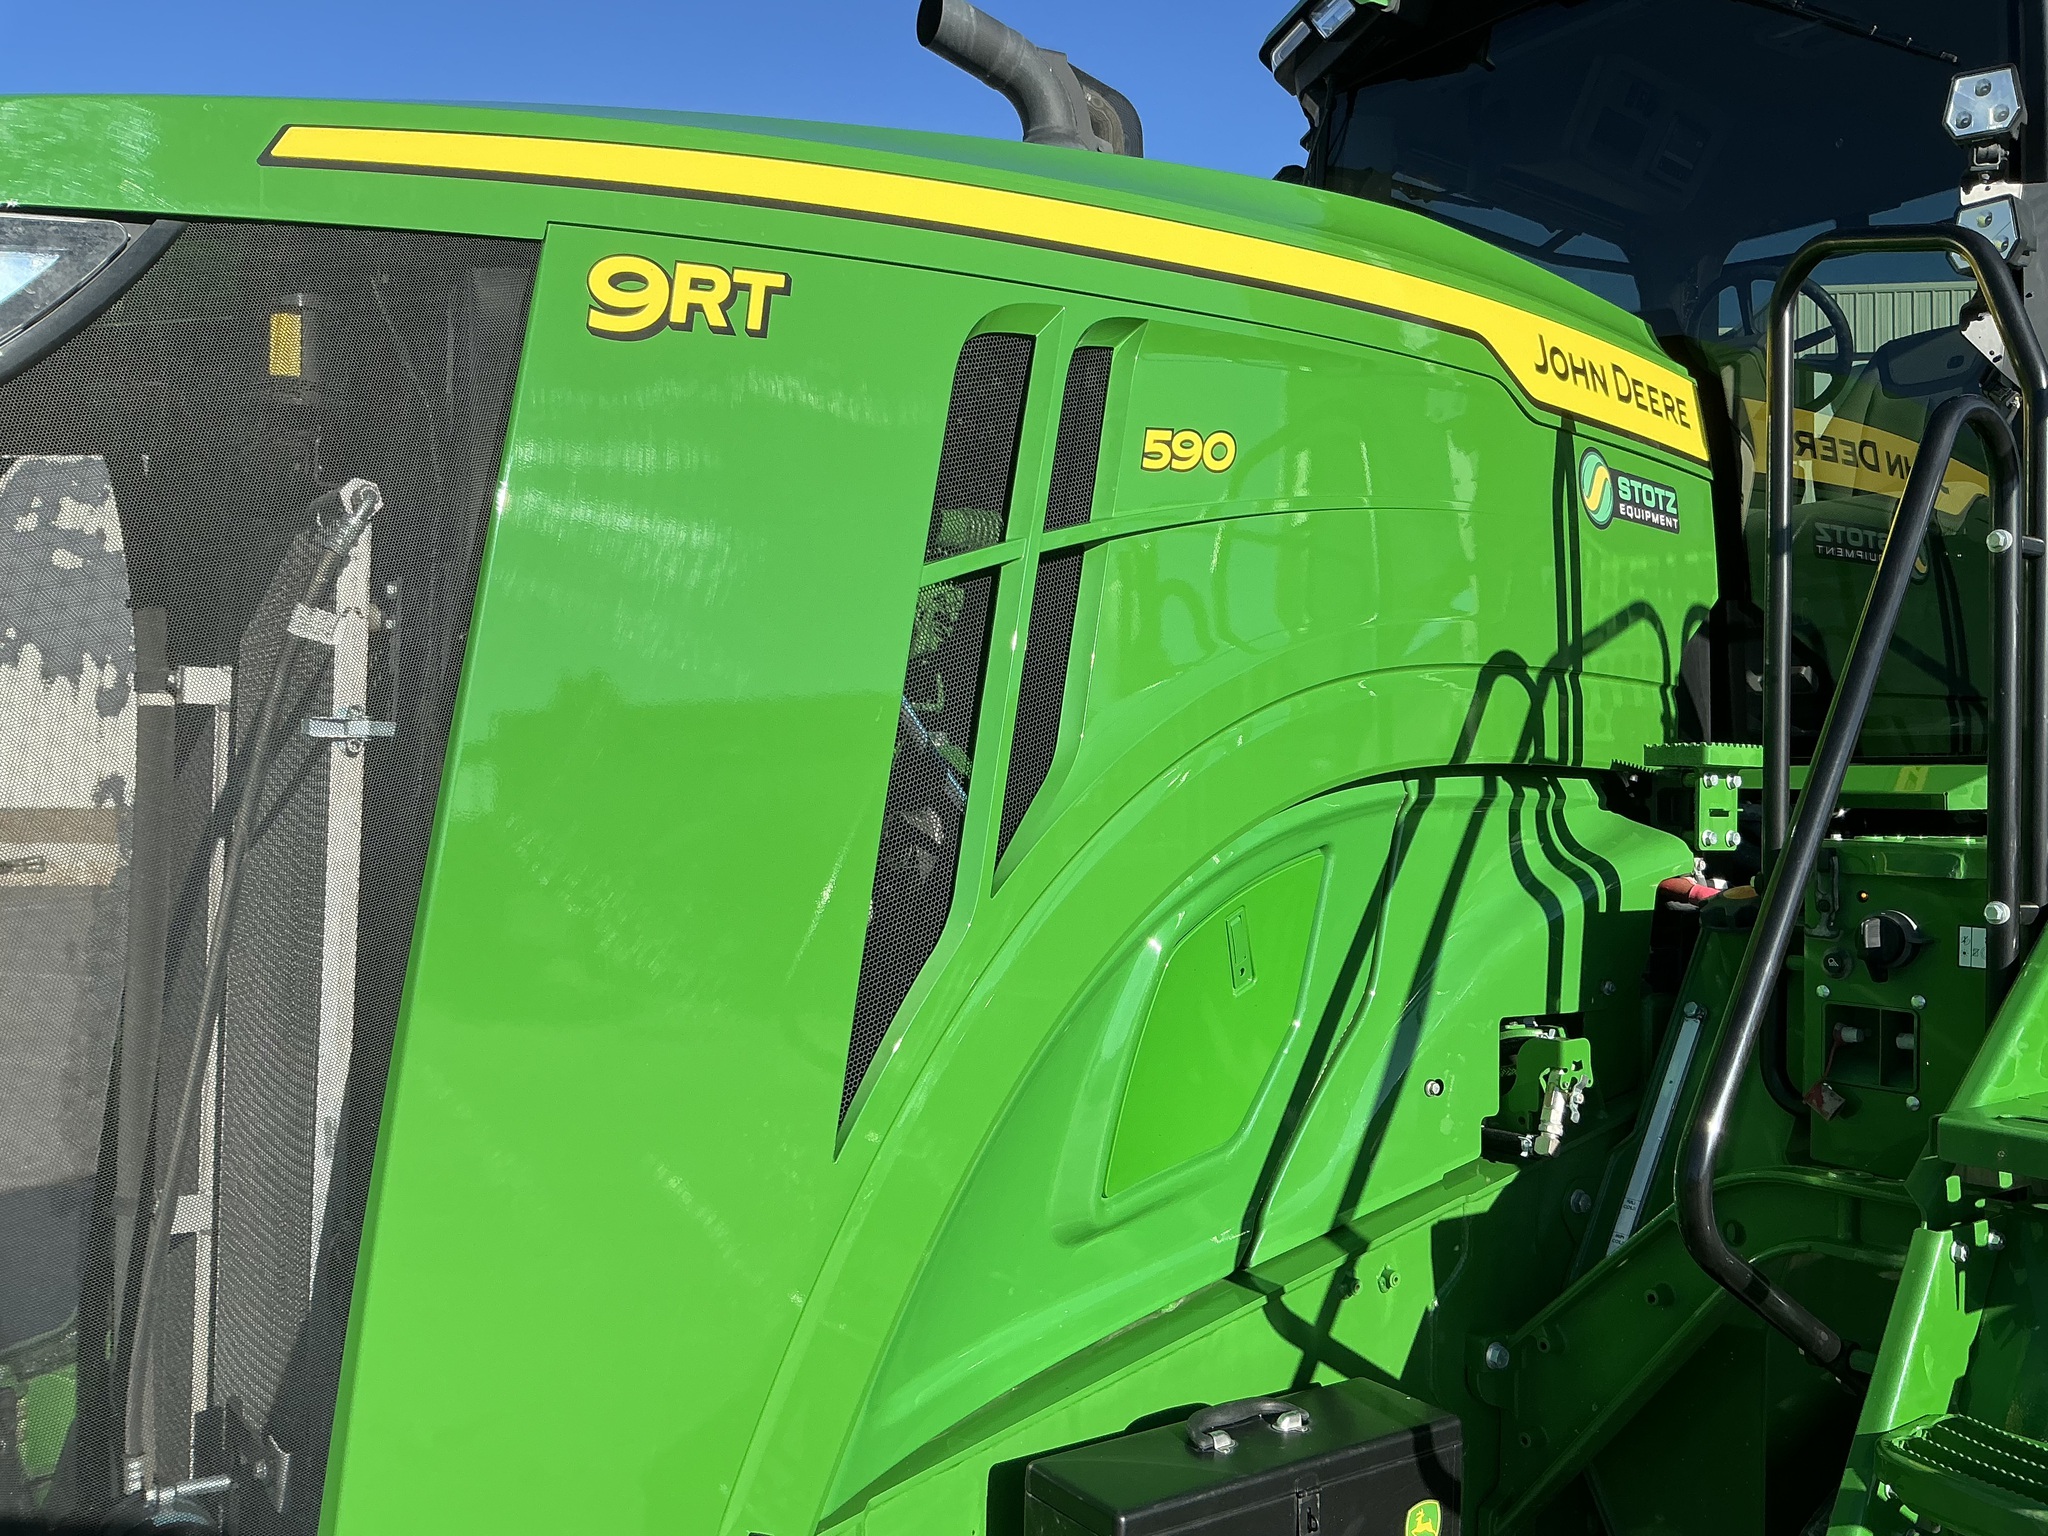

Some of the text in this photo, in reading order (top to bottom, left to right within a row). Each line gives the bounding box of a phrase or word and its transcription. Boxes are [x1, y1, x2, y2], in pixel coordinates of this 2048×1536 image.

[586, 254, 792, 341] 9RT
[1534, 334, 1691, 430] JOHN DEERE
[1141, 427, 1237, 474] 590
[1617, 476, 1678, 515] STOTZ
[1619, 503, 1679, 530] EQUIPMENT
